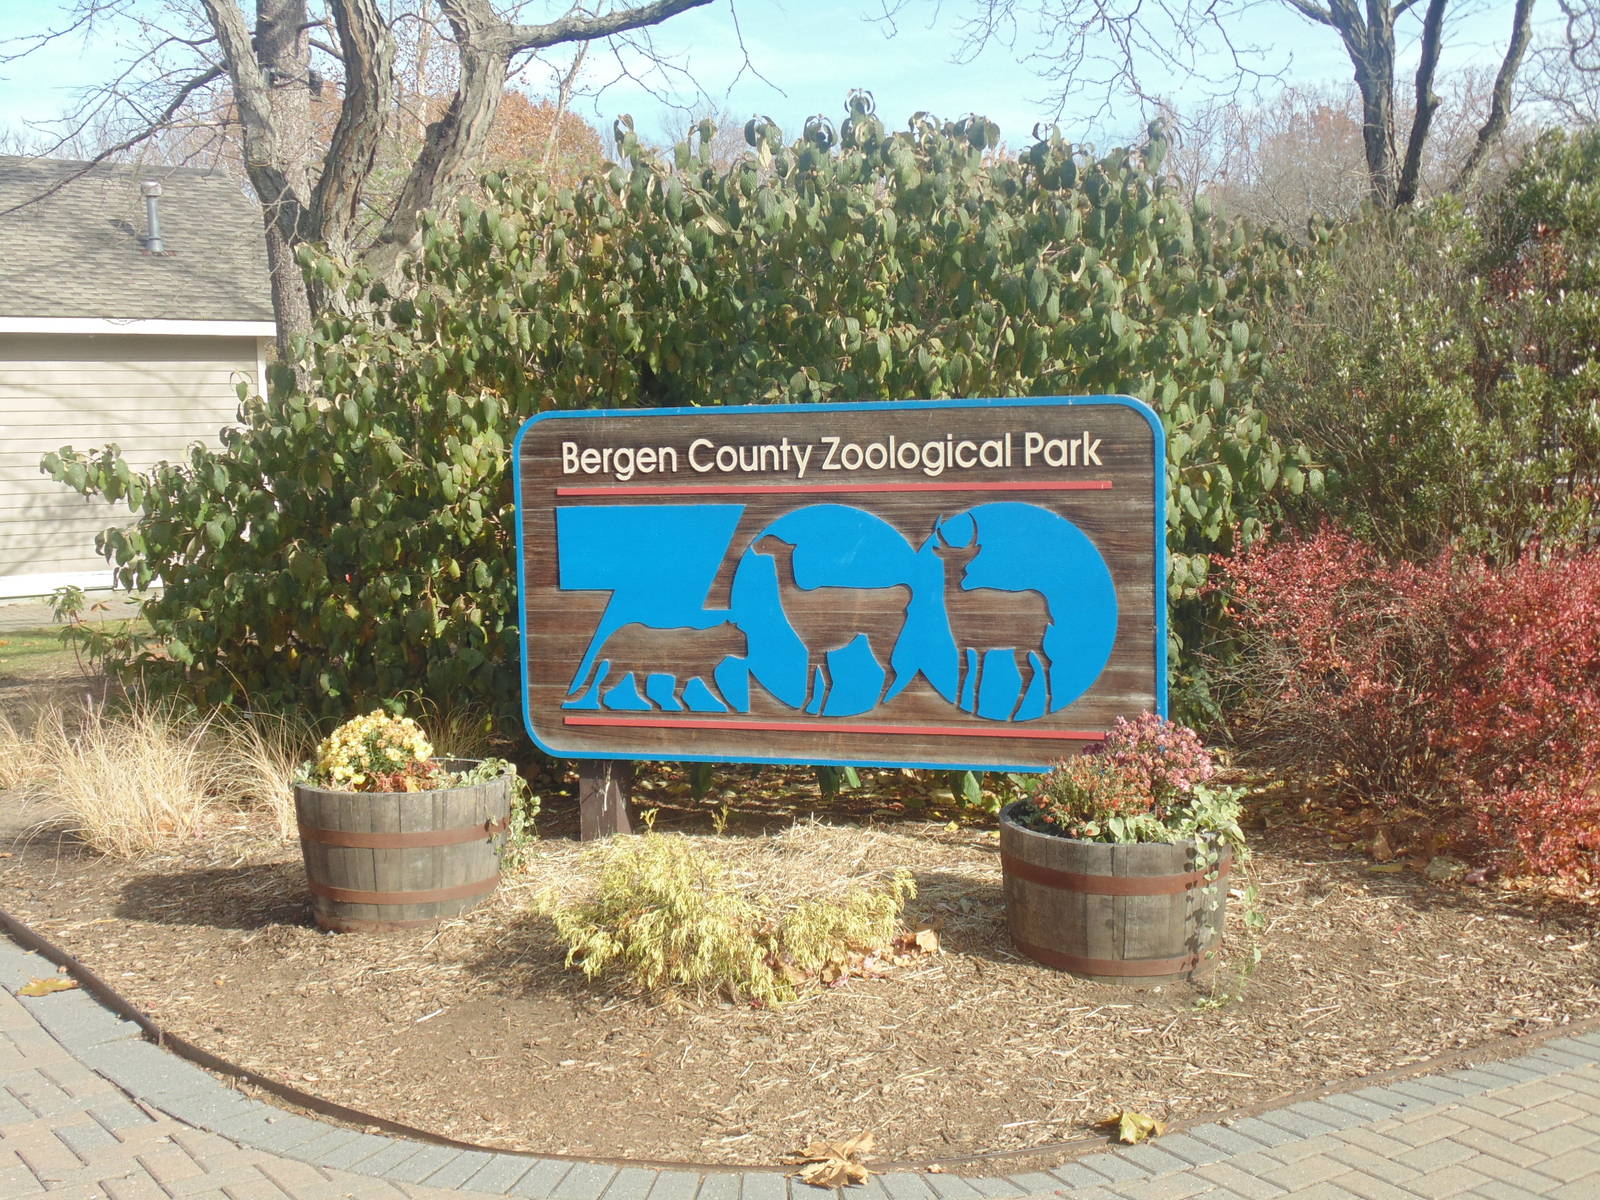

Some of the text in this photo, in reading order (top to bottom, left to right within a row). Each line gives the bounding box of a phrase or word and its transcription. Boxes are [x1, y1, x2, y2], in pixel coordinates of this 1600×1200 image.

[561, 430, 1104, 481] Bergen County Zoological Park
